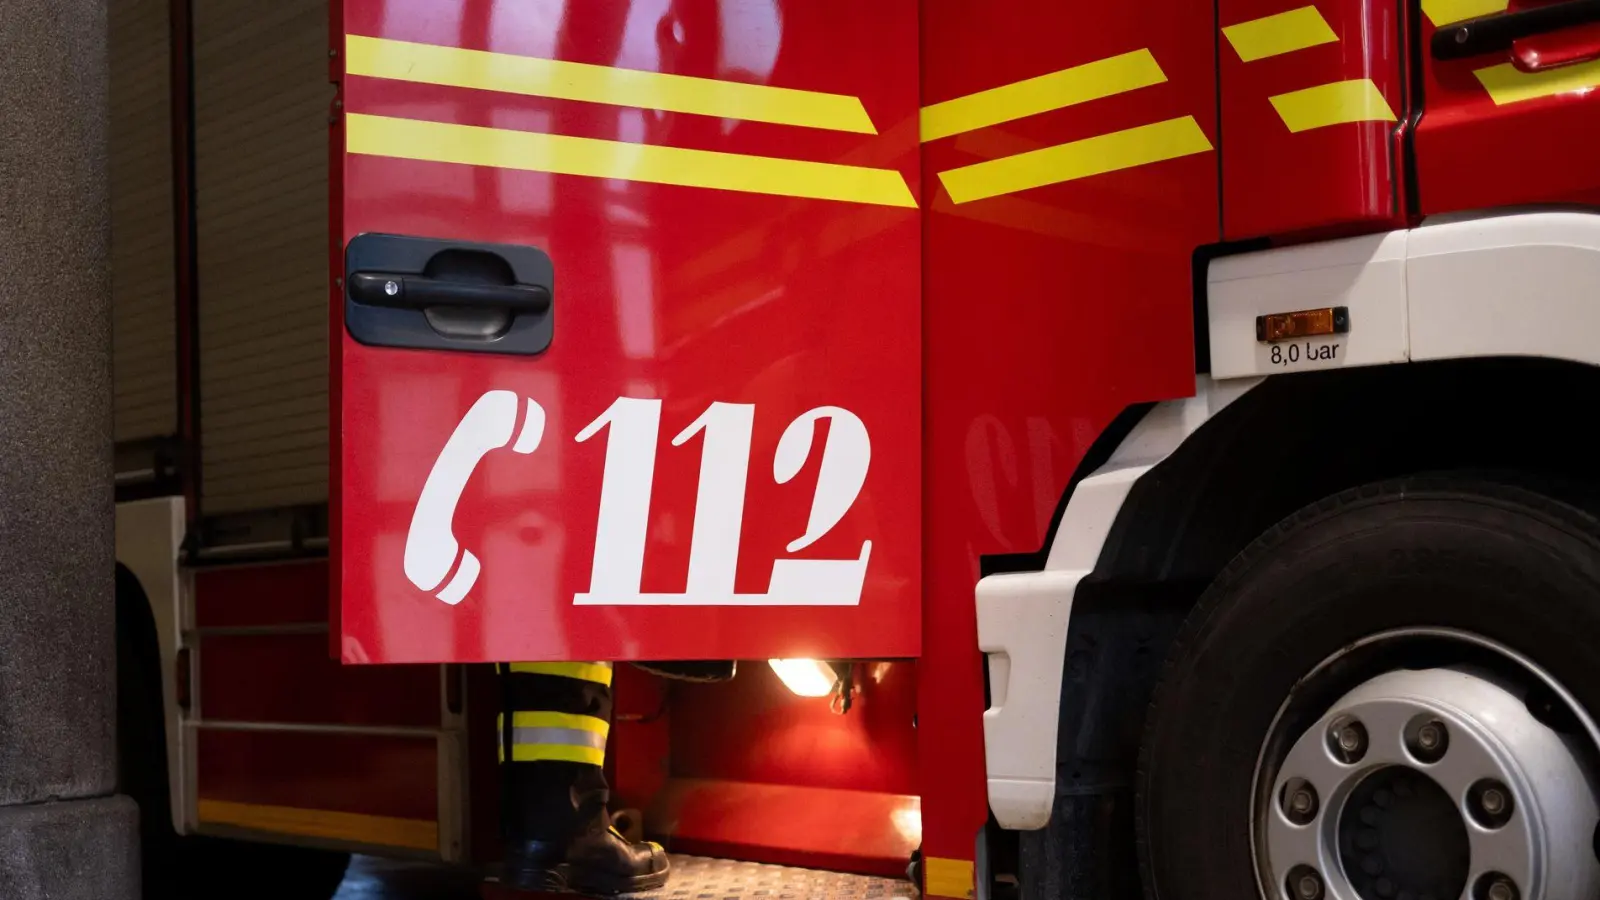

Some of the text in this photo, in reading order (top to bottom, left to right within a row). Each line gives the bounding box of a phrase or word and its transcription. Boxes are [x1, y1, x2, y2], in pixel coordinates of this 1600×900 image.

[1271, 342, 1339, 365] 8,0 bar
[573, 396, 872, 606] 112
